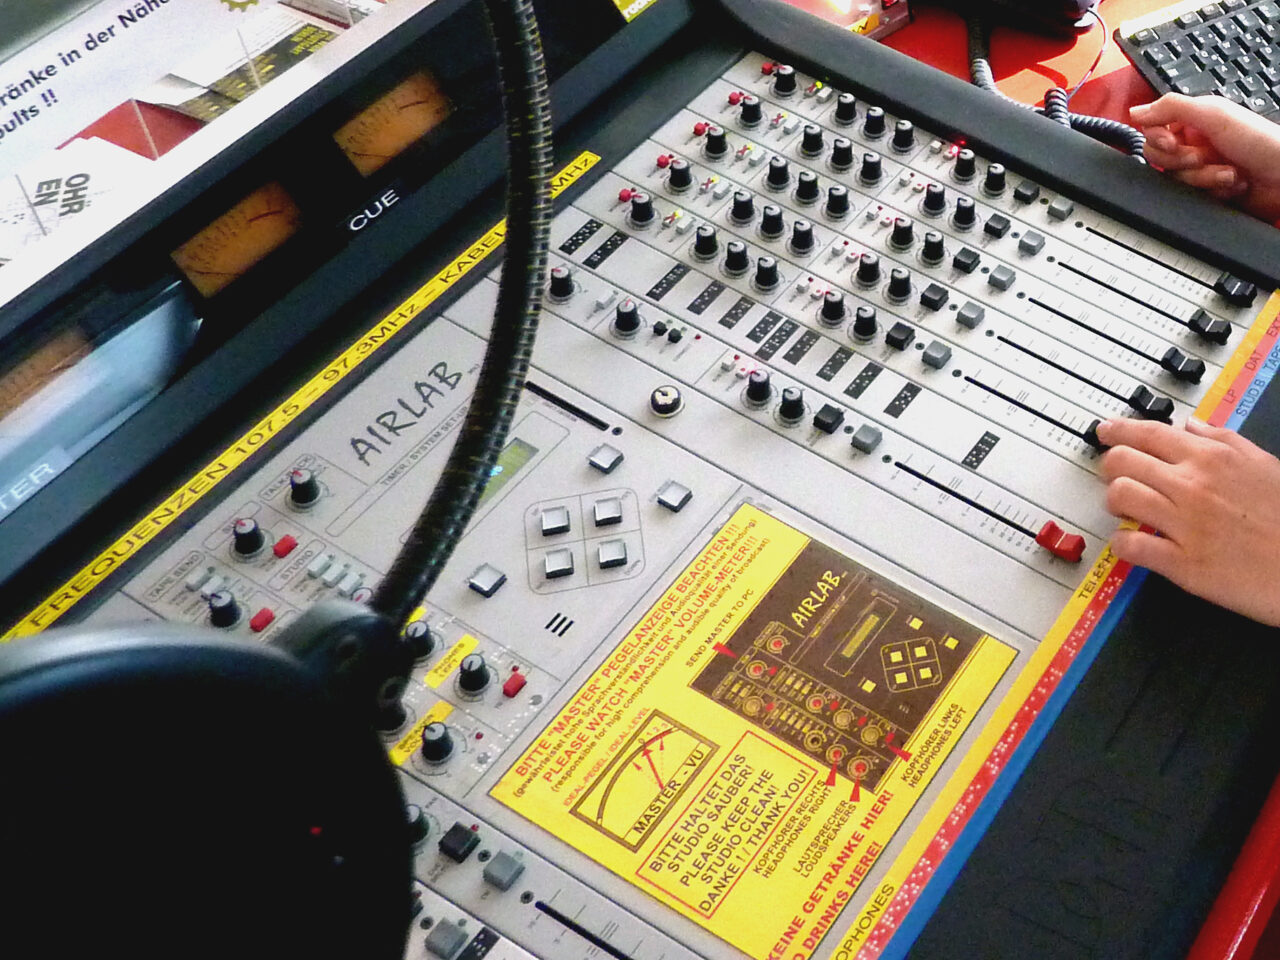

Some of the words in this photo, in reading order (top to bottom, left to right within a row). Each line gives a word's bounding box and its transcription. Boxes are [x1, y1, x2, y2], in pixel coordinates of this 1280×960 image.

[58, 49, 82, 66] in
[84, 24, 116, 51] der
[349, 189, 401, 232] CUE
[1223, 389, 1236, 405] LP
[1244, 351, 1263, 372] DAT
[350, 361, 462, 467] AIRLAB
[381, 461, 407, 487] TIMER
[411, 430, 442, 461] SYSTEM
[440, 405, 469, 432] SET-UP
[29, 462, 229, 628] FREQUENZEN
[235, 402, 300, 455] 107.5
[323, 303, 420, 382] 97.3MHz
[280, 550, 315, 581] STUDIO
[791, 569, 841, 629] AIRLAB
[515, 738, 552, 776] BITTE
[602, 593, 679, 678] PEGELANZEIGE
[676, 536, 729, 593] BEACHTEN
[726, 524, 740, 538] !!!
[564, 717, 585, 740] hohe
[658, 617, 672, 632] und
[670, 567, 713, 617] Audioqualität
[712, 550, 729, 570] einer
[685, 645, 707, 668] SEND
[705, 612, 736, 646] MASTER
[732, 598, 745, 612] TO
[742, 588, 755, 601] PC
[542, 732, 584, 783] PLEASE
[586, 687, 629, 732] WATCH
[551, 741, 597, 793] (responsible
[595, 727, 608, 741] for
[606, 708, 625, 728] high
[623, 647, 674, 708] comprehension
[674, 634, 687, 649] and
[687, 609, 710, 635] audible
[708, 584, 732, 610] quality
[563, 759, 605, 807] IDEAL-PEGEL
[609, 706, 651, 753] IDEAL-LEVEL
[900, 727, 941, 783] KOPFHÖRER
[936, 702, 959, 730] LINKS
[907, 728, 952, 788] HEADPHONES
[948, 707, 967, 730] LEFT
[632, 779, 682, 834] MASTER
[686, 749, 705, 768] VU
[649, 833, 685, 873] BITTE
[680, 781, 725, 834] HALTET
[720, 753, 747, 781] DAS
[667, 822, 710, 873] STUDIO
[707, 765, 755, 823] SAUBER!
[679, 833, 726, 887] PLEASE
[721, 796, 750, 834] KEEP
[748, 768, 774, 796] THE
[700, 833, 743, 885] STUDIO
[739, 784, 780, 832] CLEAN!
[762, 815, 811, 879] HEADPHONES
[809, 786, 833, 815] RIGHT
[792, 799, 849, 873] LAUTSPRECHER
[795, 779, 826, 816] RECHTS
[699, 862, 741, 913] DANKE
[747, 802, 787, 847] THANK
[781, 768, 810, 803] YOU!
[765, 915, 805, 960] KEINE
[802, 831, 865, 914] GETRÄNKE
[860, 789, 895, 830] HIER!
[801, 803, 858, 879] LOUDSPEAKERS
[802, 889, 849, 951] DRINKS
[845, 840, 883, 888] HERE!
